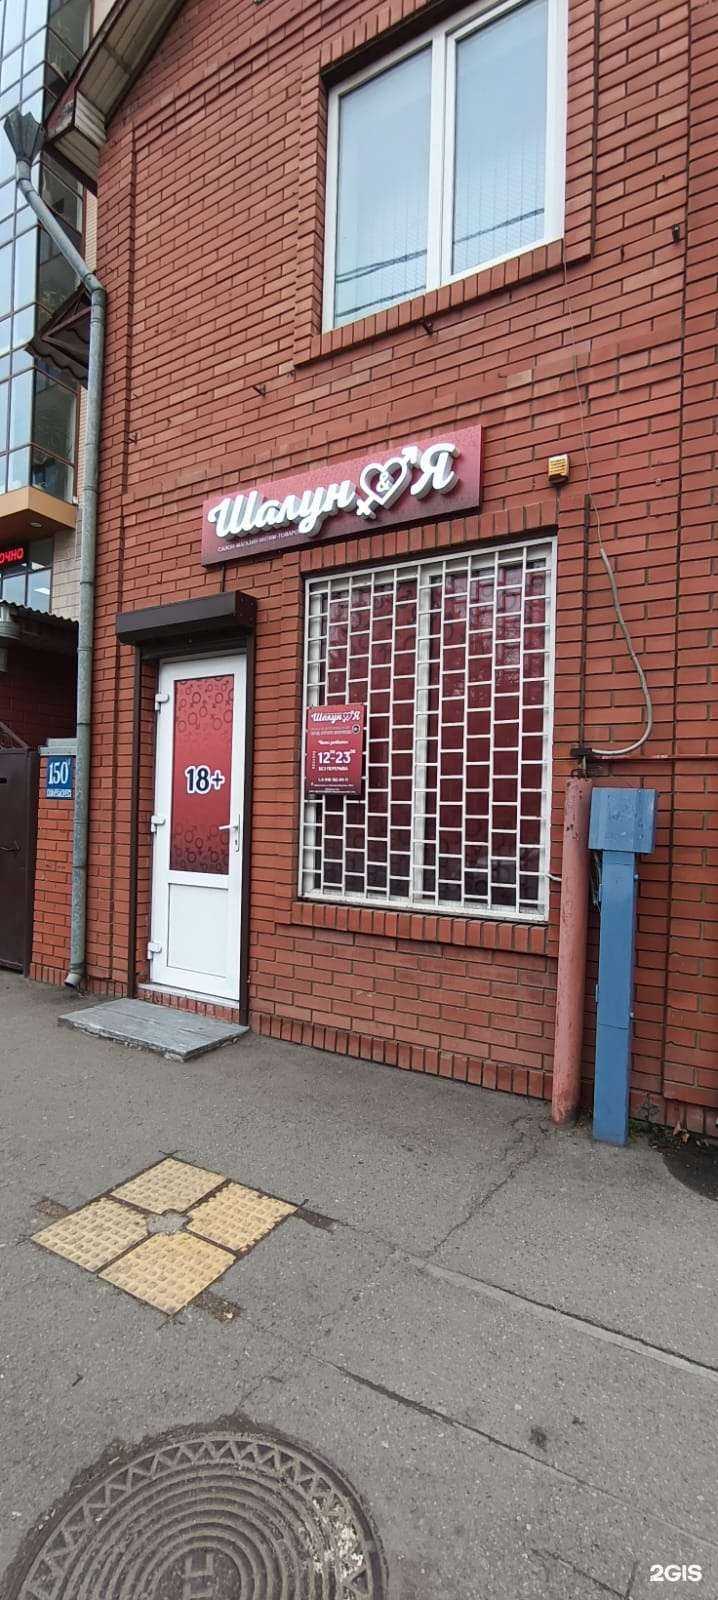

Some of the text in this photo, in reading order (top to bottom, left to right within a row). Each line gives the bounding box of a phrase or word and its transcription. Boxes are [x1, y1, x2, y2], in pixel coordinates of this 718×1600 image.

[208, 479, 356, 538] Шалун
[411, 442, 461, 498] Я
[311, 711, 343, 724] Шалун
[185, 765, 225, 794] 18+
